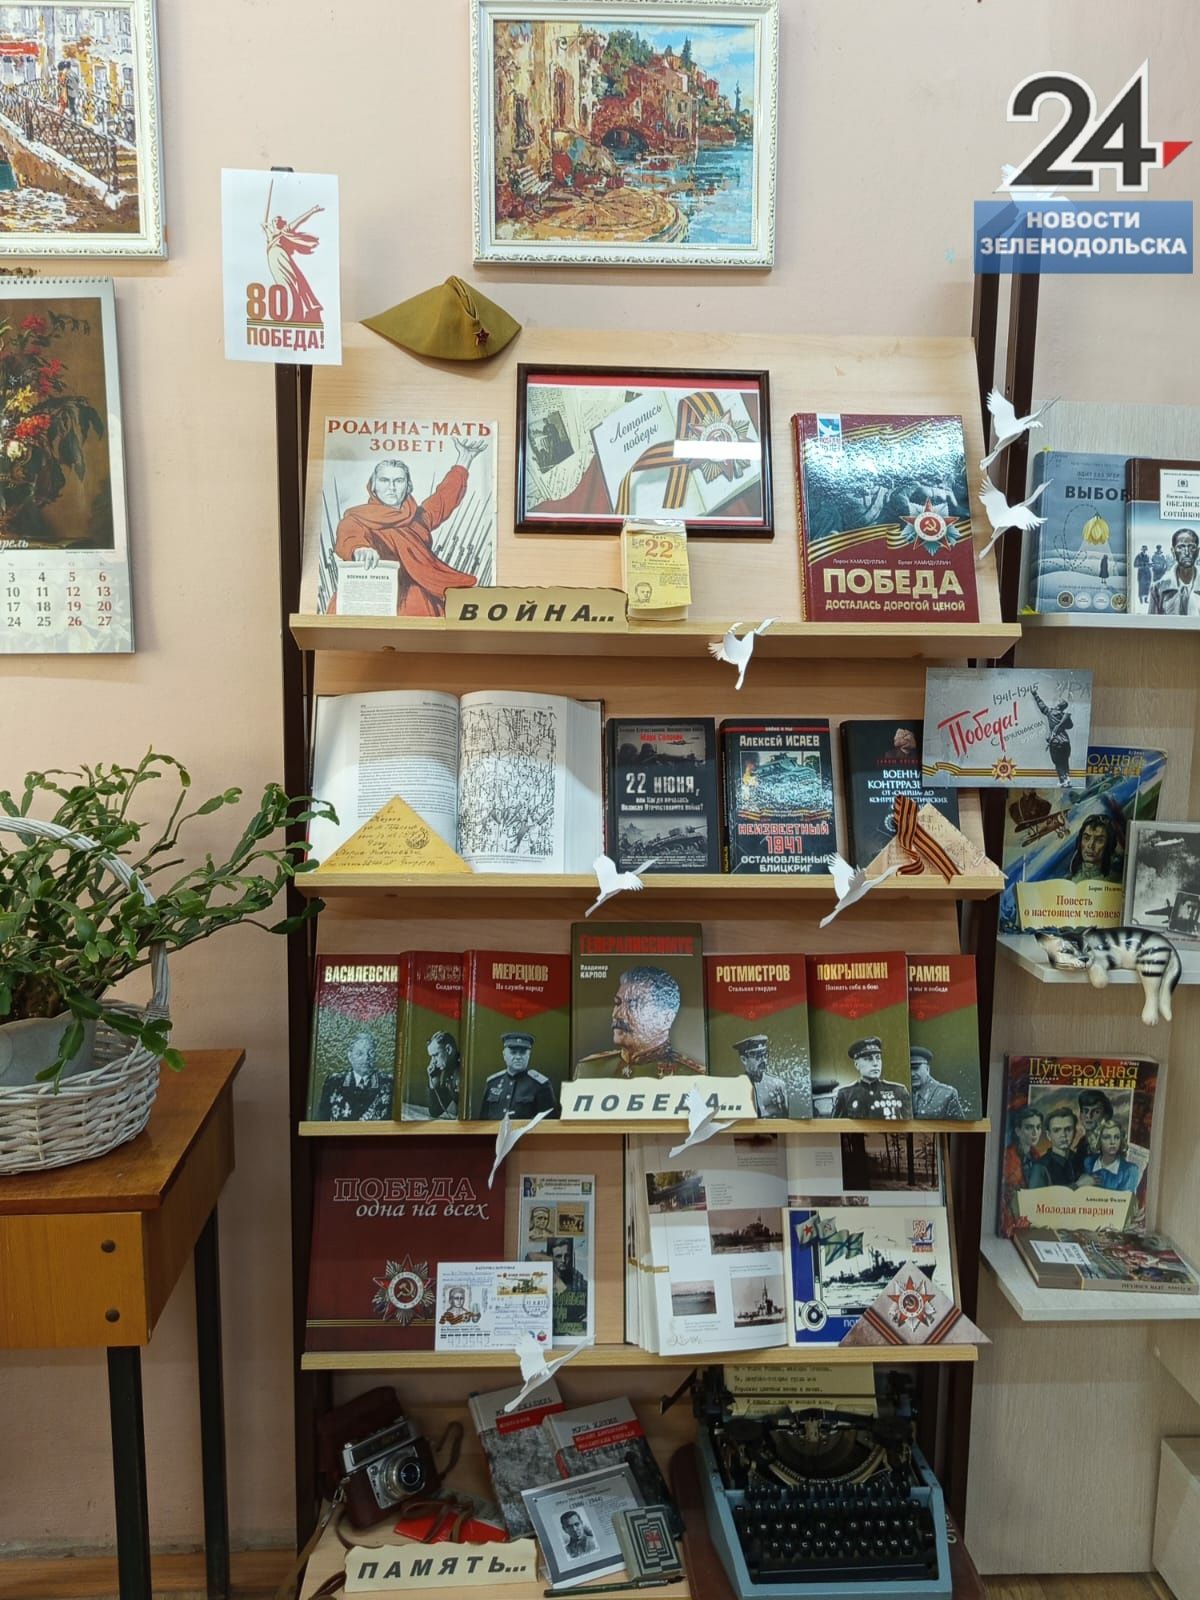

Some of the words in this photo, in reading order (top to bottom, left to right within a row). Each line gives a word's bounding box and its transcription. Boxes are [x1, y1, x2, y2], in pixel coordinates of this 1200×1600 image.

[246, 283, 289, 322] 80
[246, 327, 324, 352] ПОБЕДА!
[328, 420, 491, 437] РОДИНА-МАТЬ
[610, 404, 662, 443] Летопись
[370, 438, 444, 453] ЗОВЕТ!
[623, 424, 659, 453] победы
[645, 539, 674, 558] 22
[8, 572, 16, 582] 3
[38, 572, 46, 582] 4
[69, 572, 76, 582] 5
[99, 572, 106, 582] 6
[823, 568, 964, 599] ПОБЕДА
[6, 587, 20, 597] 10
[36, 587, 49, 597] 11
[66, 587, 80, 597] 12
[97, 587, 111, 597] 13
[7, 601, 21, 612] 17
[37, 601, 51, 612] 18
[67, 601, 81, 612] 19
[97, 601, 112, 612] 20
[459, 600, 614, 622] ВОЙНА...
[825, 600, 881, 610] ДОСТАЛАСЬ
[883, 600, 930, 611] ДОРОГОЙ
[932, 600, 966, 612] ЦЕНОЙ
[7, 616, 21, 627] 24
[37, 616, 51, 627] 25
[68, 616, 82, 627] 26
[98, 616, 112, 627] 27
[937, 701, 1019, 757] Победа!
[786, 735, 820, 747] ИСАЕВ
[626, 773, 647, 794] 22
[737, 821, 830, 836] НЕИЗВЕСТНЫЙ
[766, 836, 803, 854] 1941
[741, 854, 830, 865] ОСТАНОВЛЕННЫЙ
[759, 864, 812, 874] БЛИЦКРИГ
[1056, 895, 1093, 906] Повесть
[1031, 909, 1081, 918] настоящем
[492, 962, 549, 983] МЕРЕЦКОВ
[716, 964, 791, 983] РОТМИСТРОВ
[817, 962, 888, 981] ПОКРЫШКИН
[334, 1177, 476, 1204] ПОБЕДА
[356, 1199, 405, 1217] одна
[412, 1205, 437, 1217] на
[443, 1199, 489, 1220] всех
[1036, 1203, 1077, 1214] Молодая
[1078, 1206, 1114, 1217] гвардия
[358, 1556, 527, 1579] ПАМЯТЬ...
